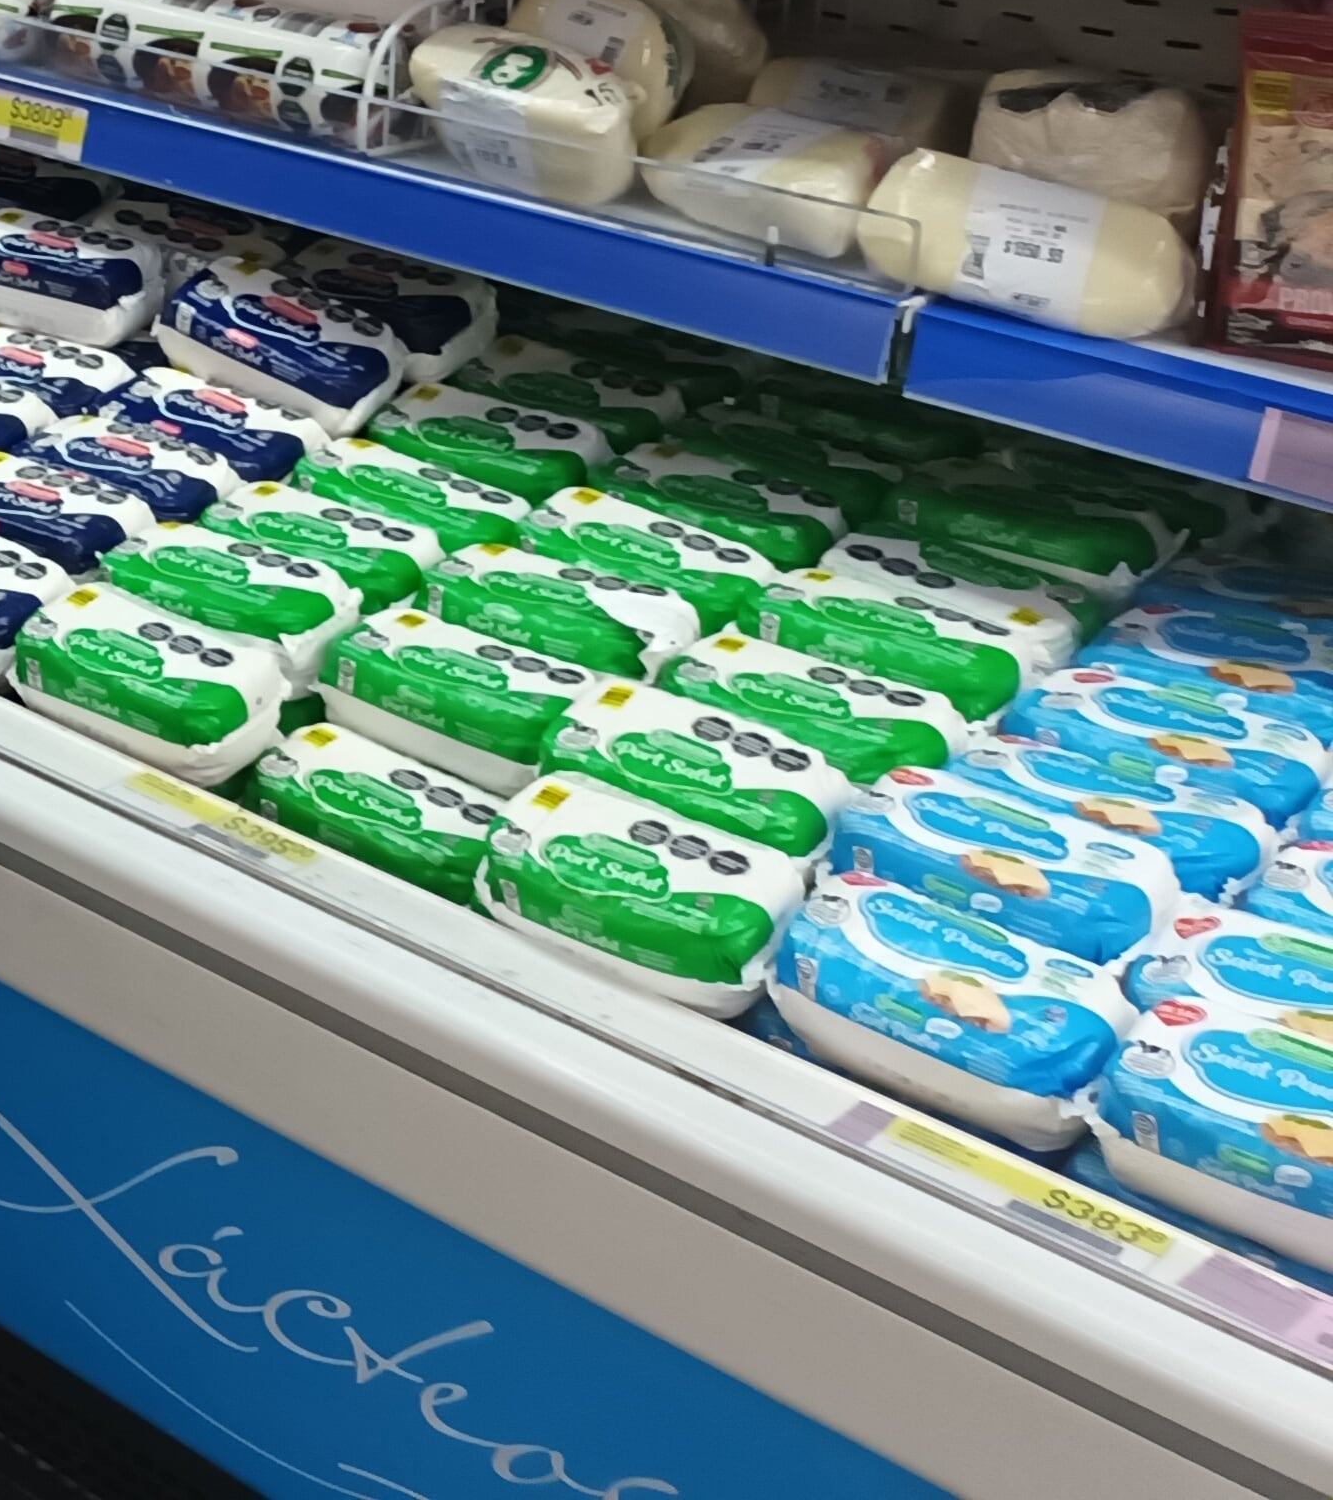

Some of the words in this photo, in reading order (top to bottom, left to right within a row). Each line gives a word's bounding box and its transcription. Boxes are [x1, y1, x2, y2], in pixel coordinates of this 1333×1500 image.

[10, 96, 66, 129] $3809
[547, 842, 598, 874] Port
[599, 862, 666, 893] Salut
[1206, 948, 1285, 981] Saint
[1190, 1043, 1273, 1079] Saint
[1042, 1188, 1145, 1243] $383
